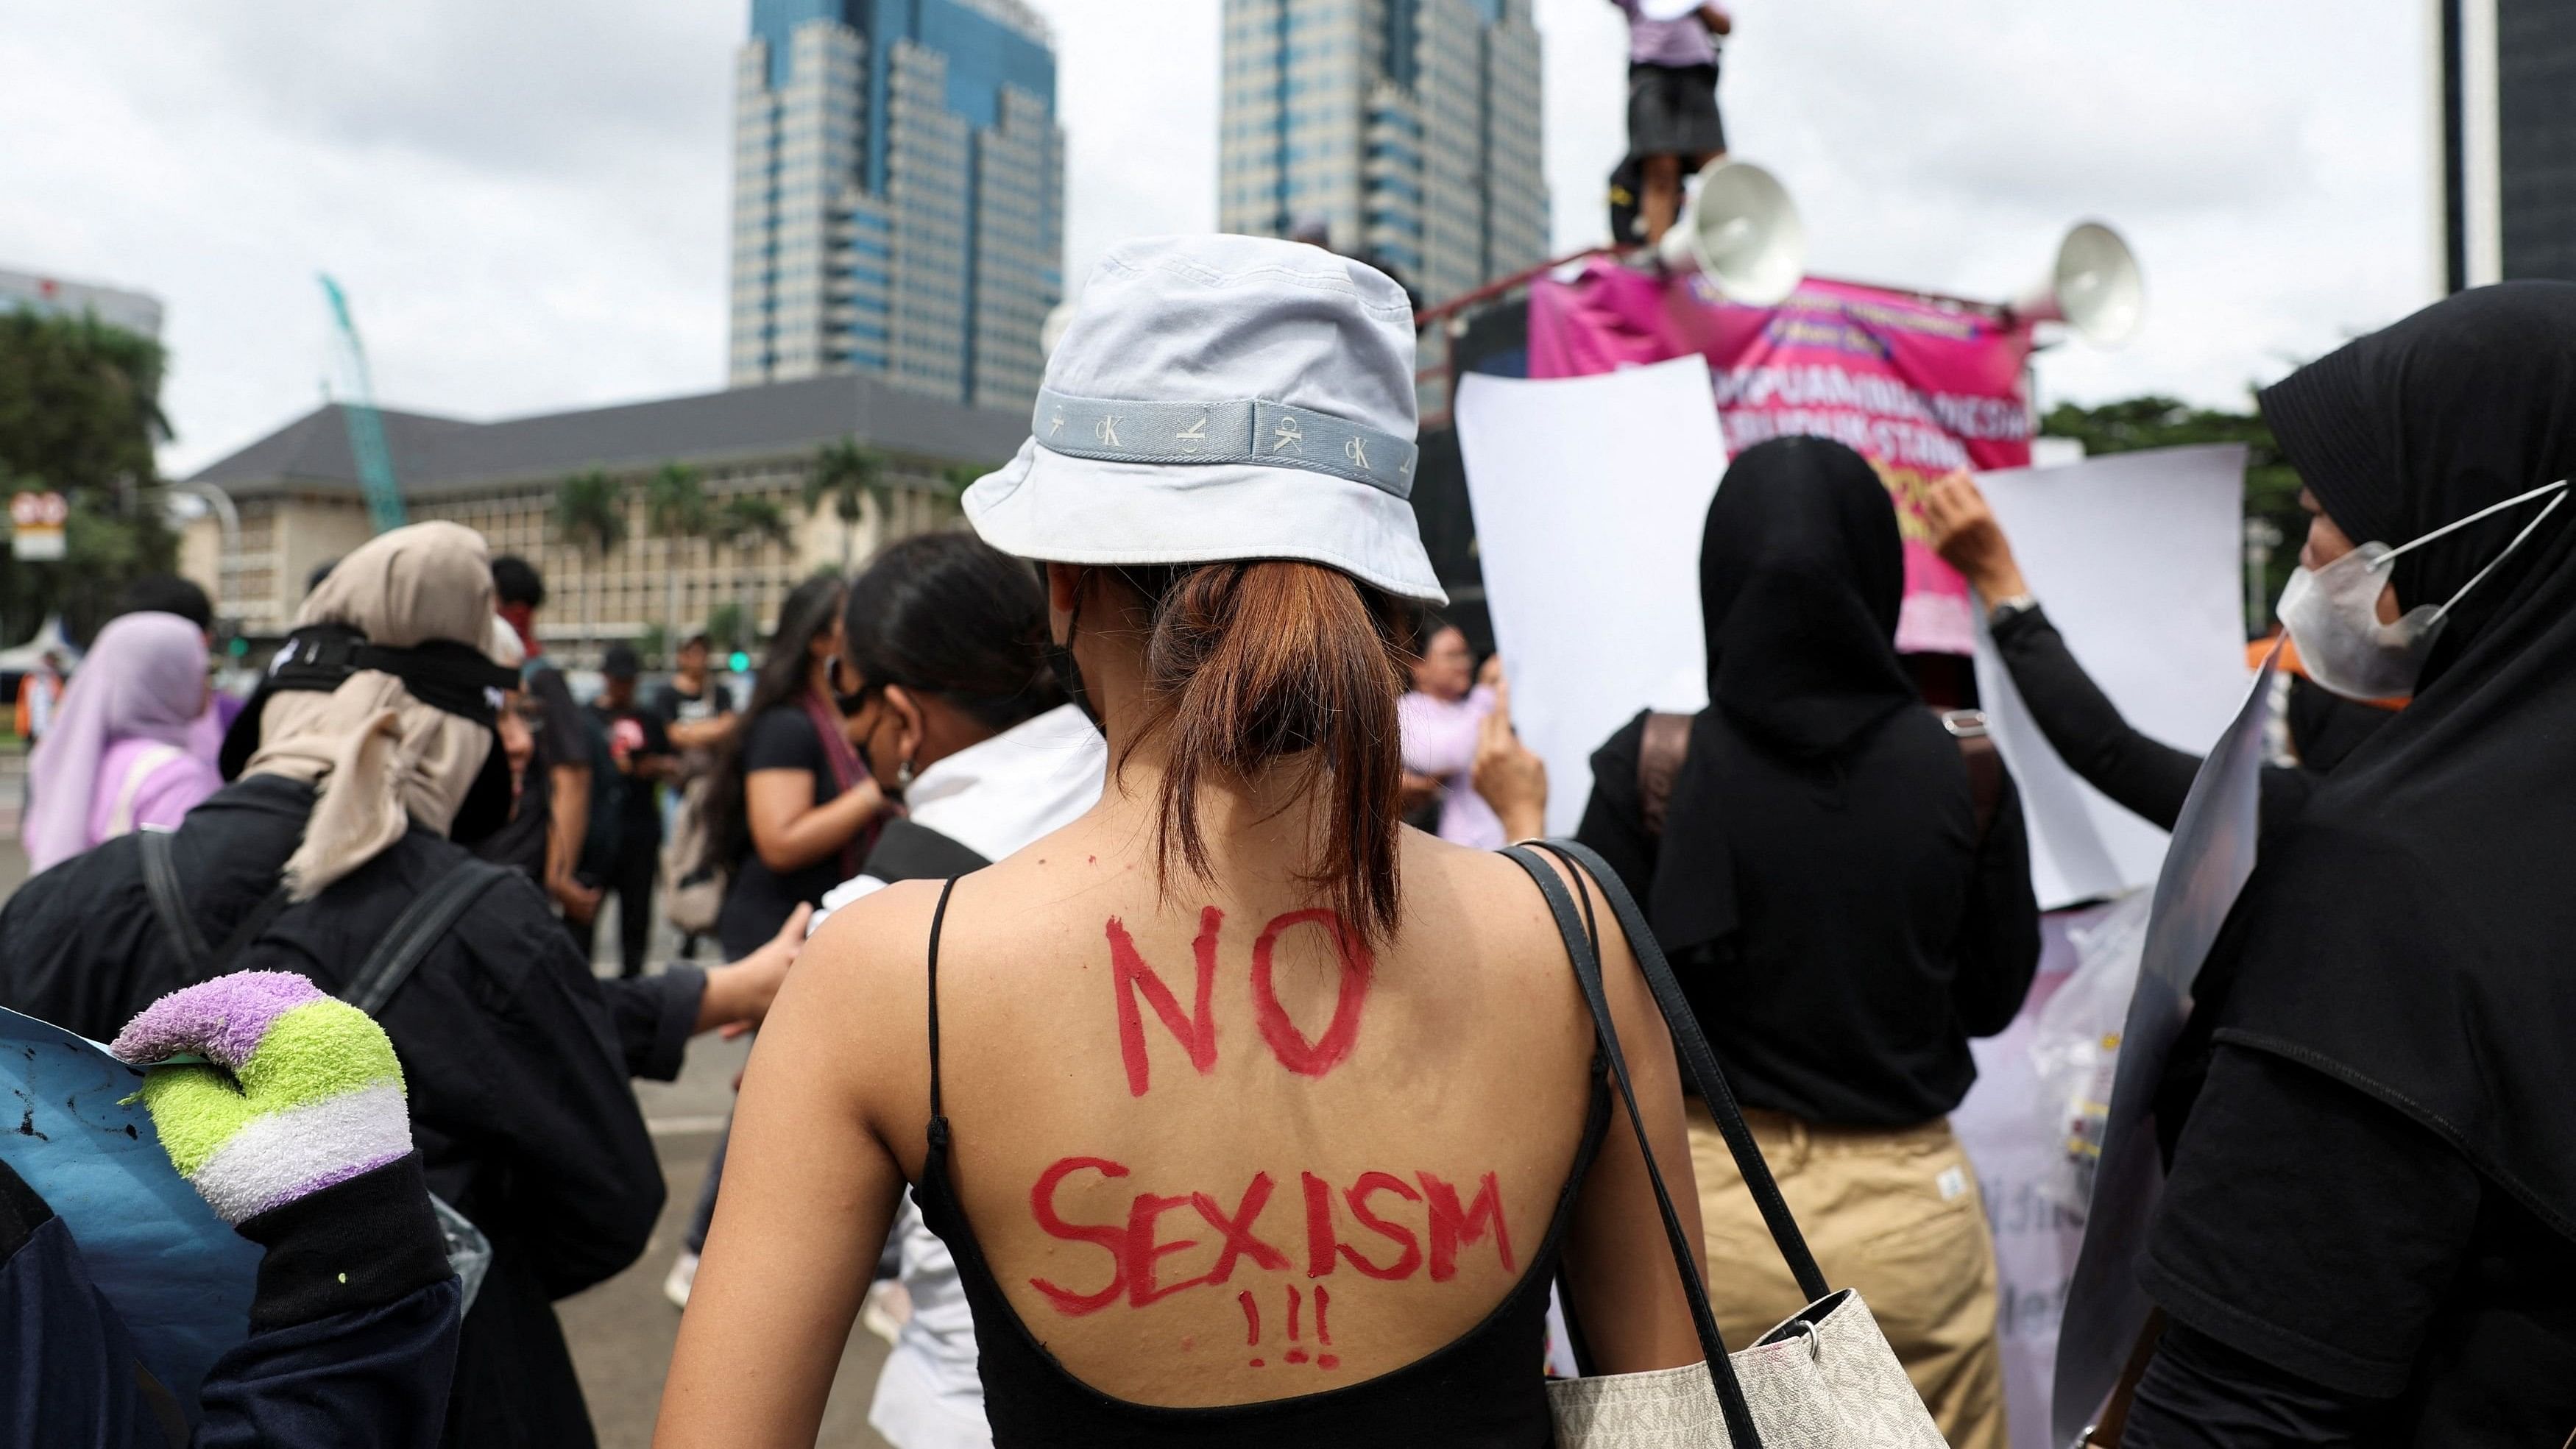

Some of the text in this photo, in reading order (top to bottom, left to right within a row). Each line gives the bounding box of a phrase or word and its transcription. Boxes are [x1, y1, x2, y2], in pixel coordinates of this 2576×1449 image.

[1106, 906, 1374, 1097] NO
[1030, 1156, 1515, 1317] SEXISM
[1238, 1284, 1340, 1370] !!!
